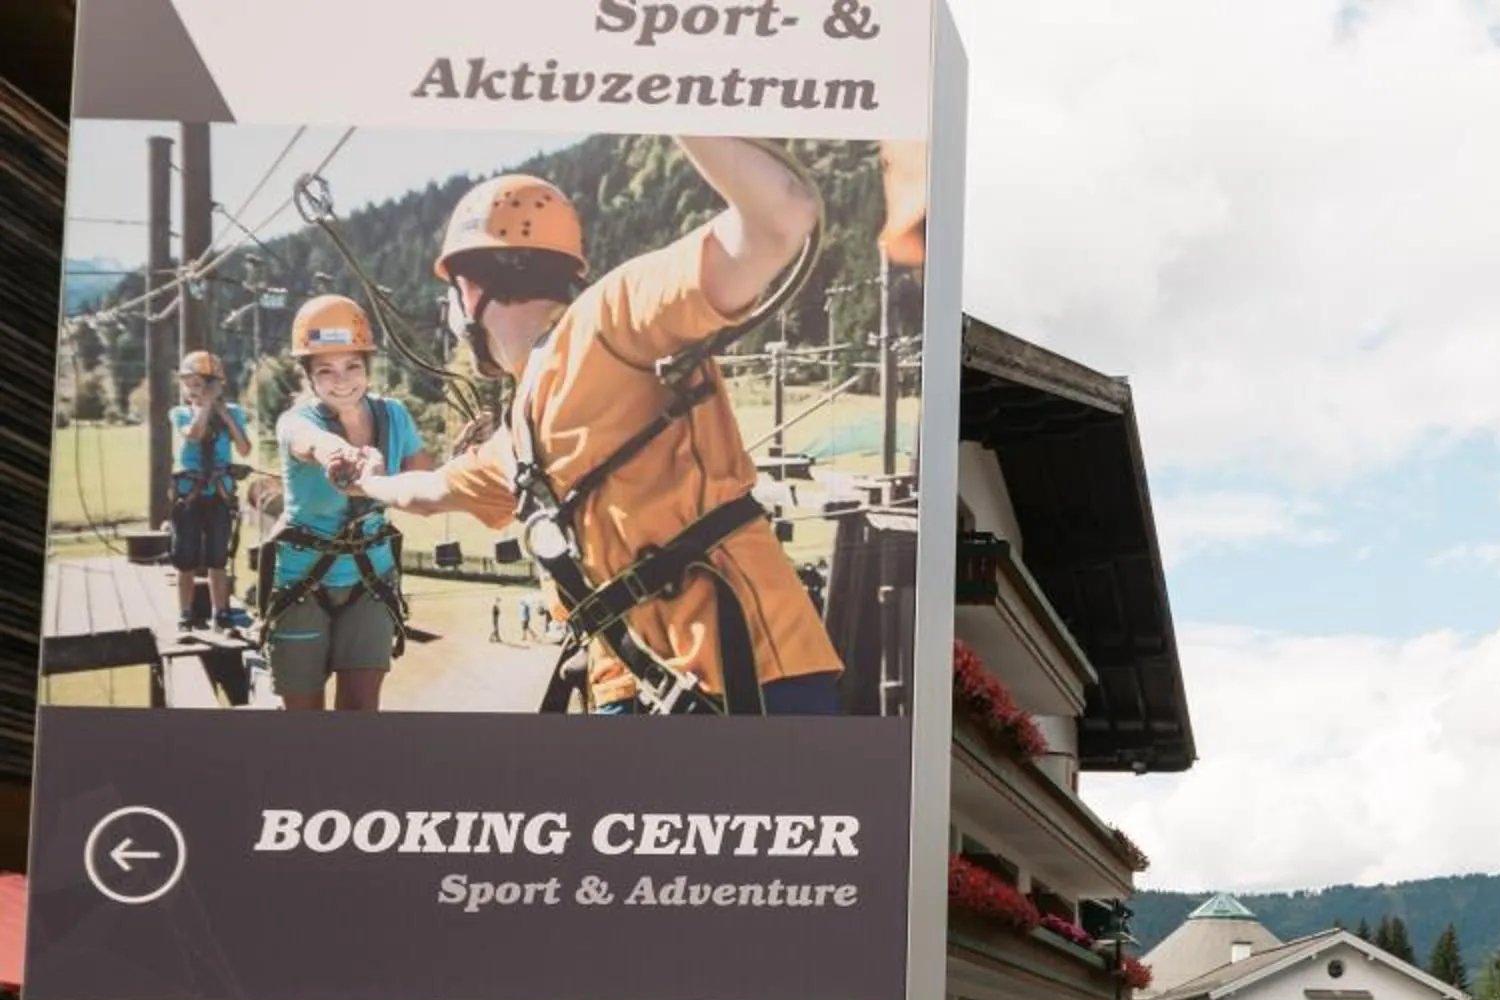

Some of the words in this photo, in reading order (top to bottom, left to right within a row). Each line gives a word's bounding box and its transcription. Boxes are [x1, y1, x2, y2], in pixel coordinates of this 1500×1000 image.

[595, 0, 799, 46] Sport-
[823, 0, 880, 40] &
[412, 57, 879, 110] Aktivzentrum
[254, 809, 571, 855] BOOKING
[592, 813, 860, 857] CENTER
[437, 874, 561, 913] Sport
[576, 876, 614, 906] &
[625, 876, 858, 908] Adventure
